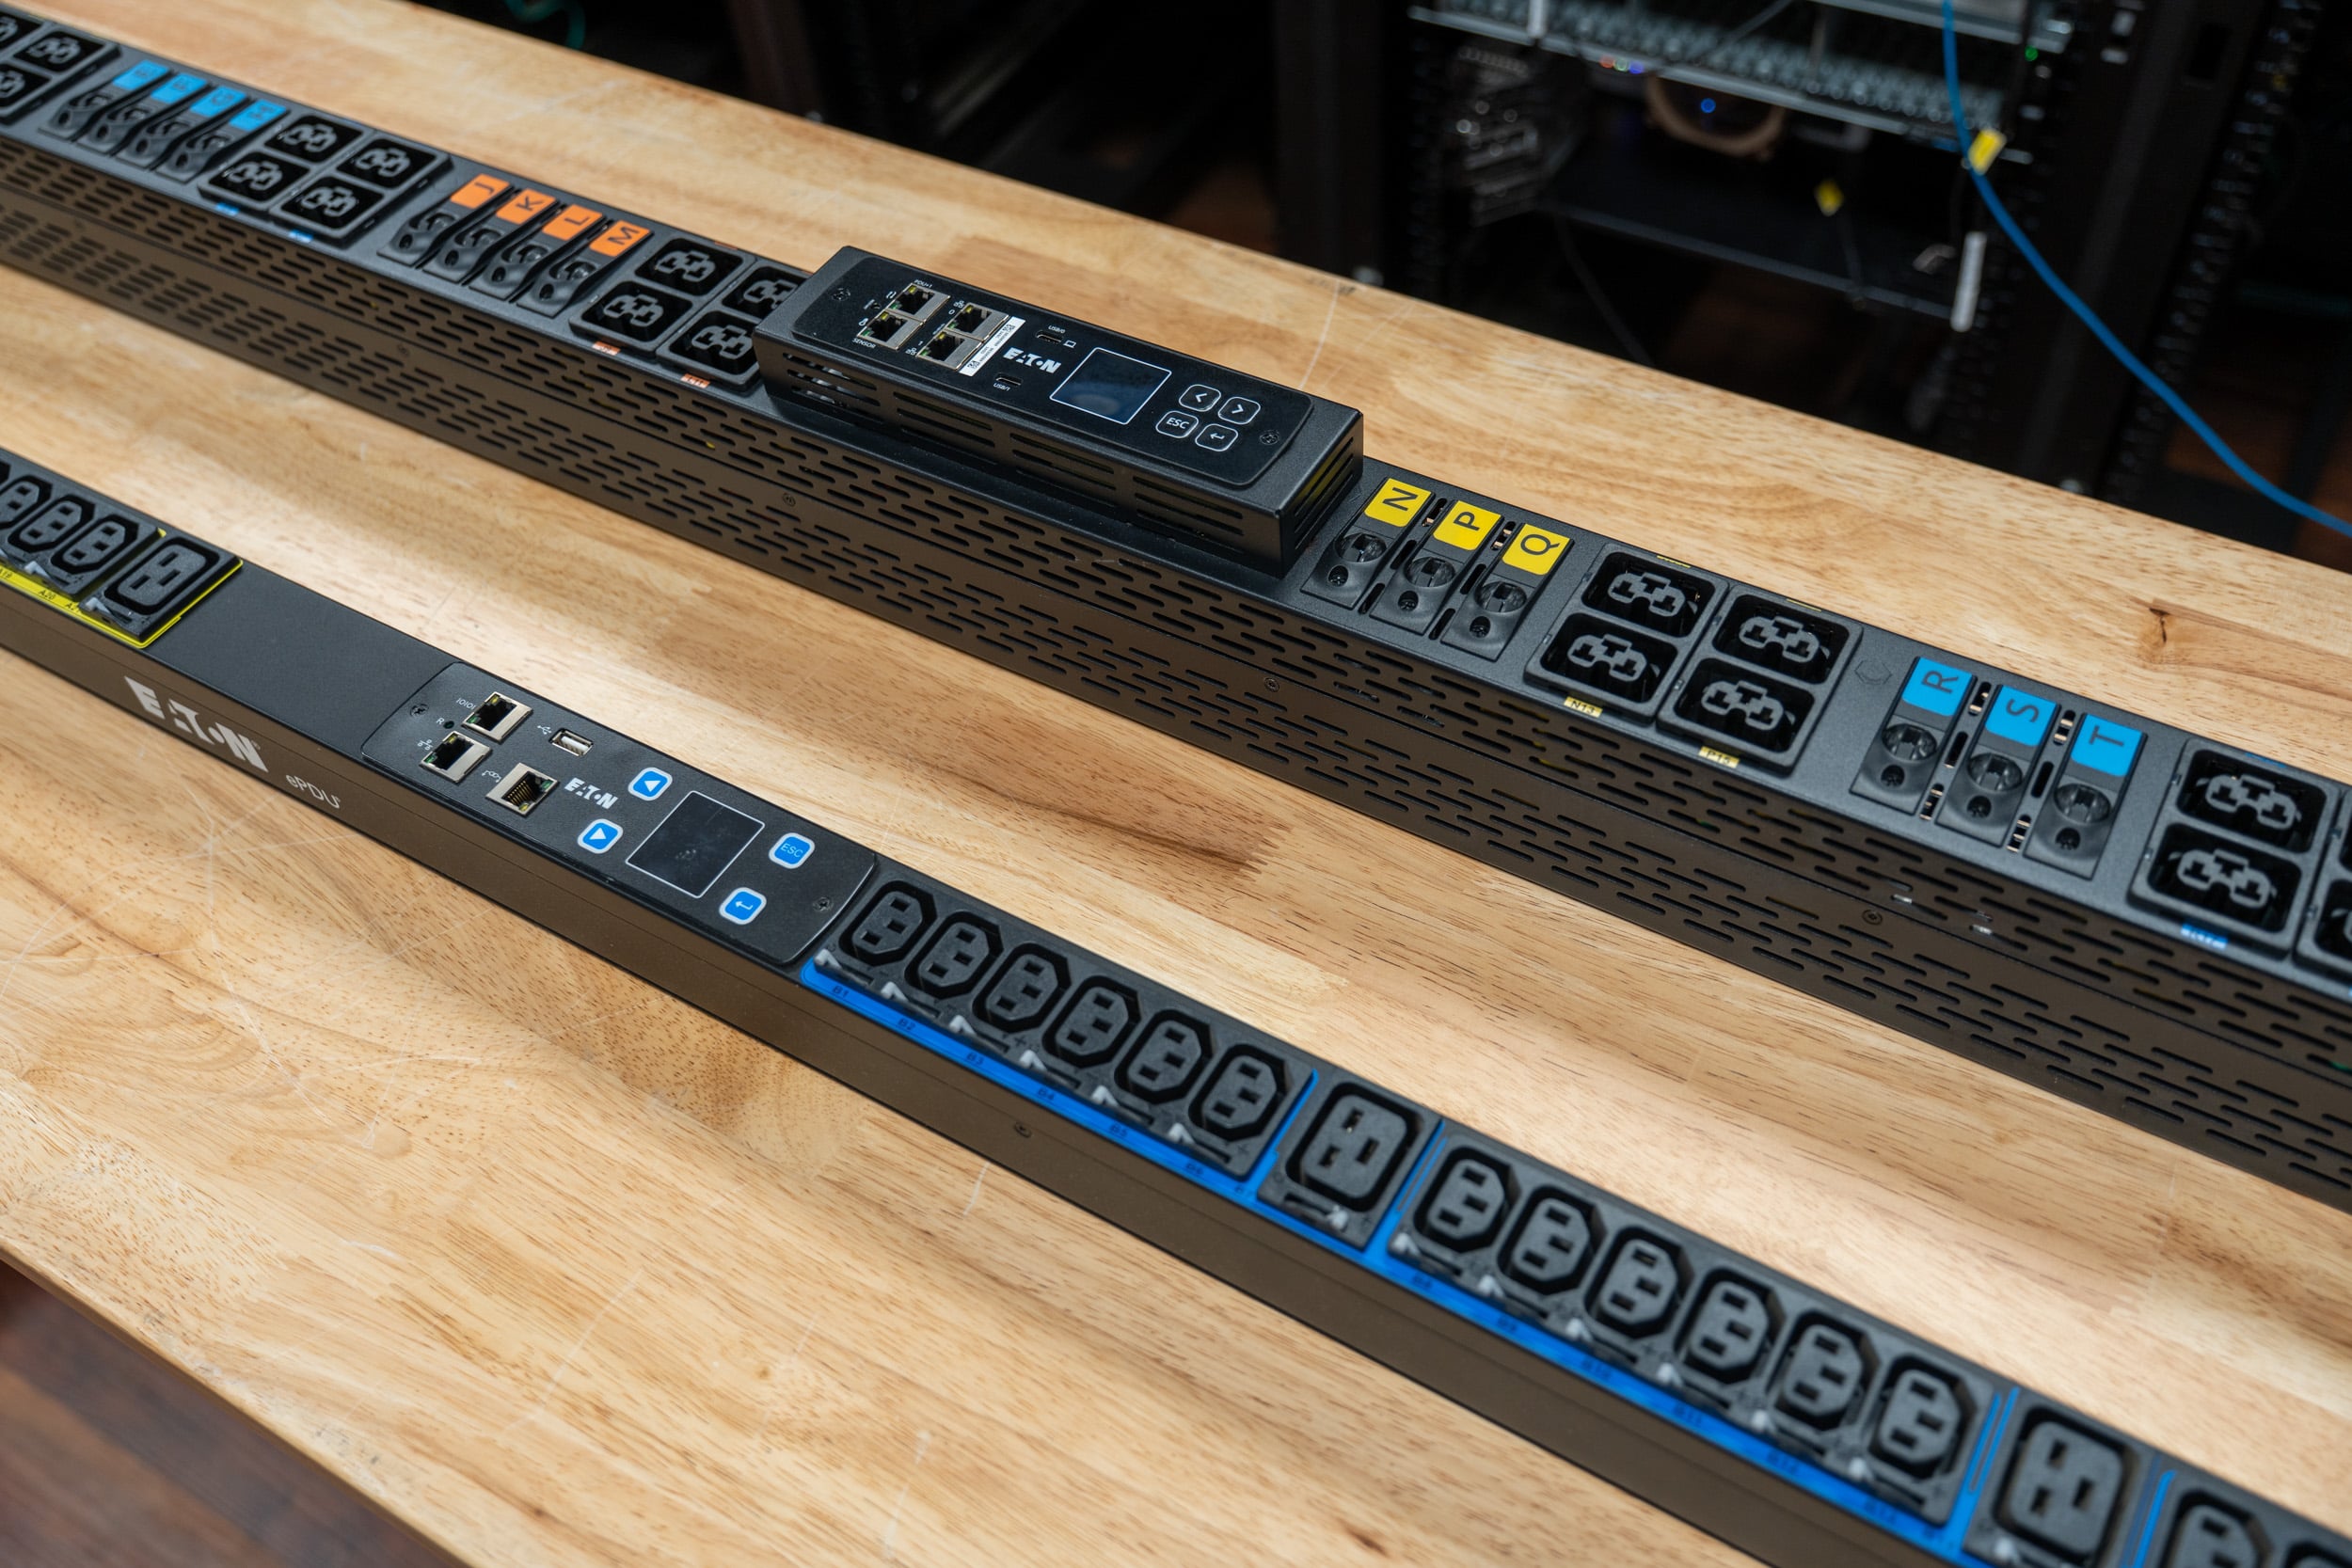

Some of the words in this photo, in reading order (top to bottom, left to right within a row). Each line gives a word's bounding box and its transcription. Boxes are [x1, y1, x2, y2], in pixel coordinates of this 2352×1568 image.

[473, 181, 495, 195] J
[516, 195, 545, 212] K
[564, 215, 590, 227] L
[608, 225, 641, 245] M
[1002, 346, 1062, 373] EATON
[1166, 417, 1190, 430] ESC
[1382, 486, 1418, 512] N
[1453, 511, 1480, 531] P
[1520, 533, 1561, 556] Q
[1921, 670, 1960, 694] R
[1571, 700, 1596, 715] N13
[2005, 699, 2040, 723] S
[124, 675, 269, 773] EATON
[436, 717, 445, 725] R
[2089, 725, 2125, 748] T
[564, 777, 619, 810] EATON
[780, 843, 803, 858] ESC
[832, 984, 850, 998] B1
[897, 1017, 916, 1031] B2
[965, 1051, 984, 1065] B3
